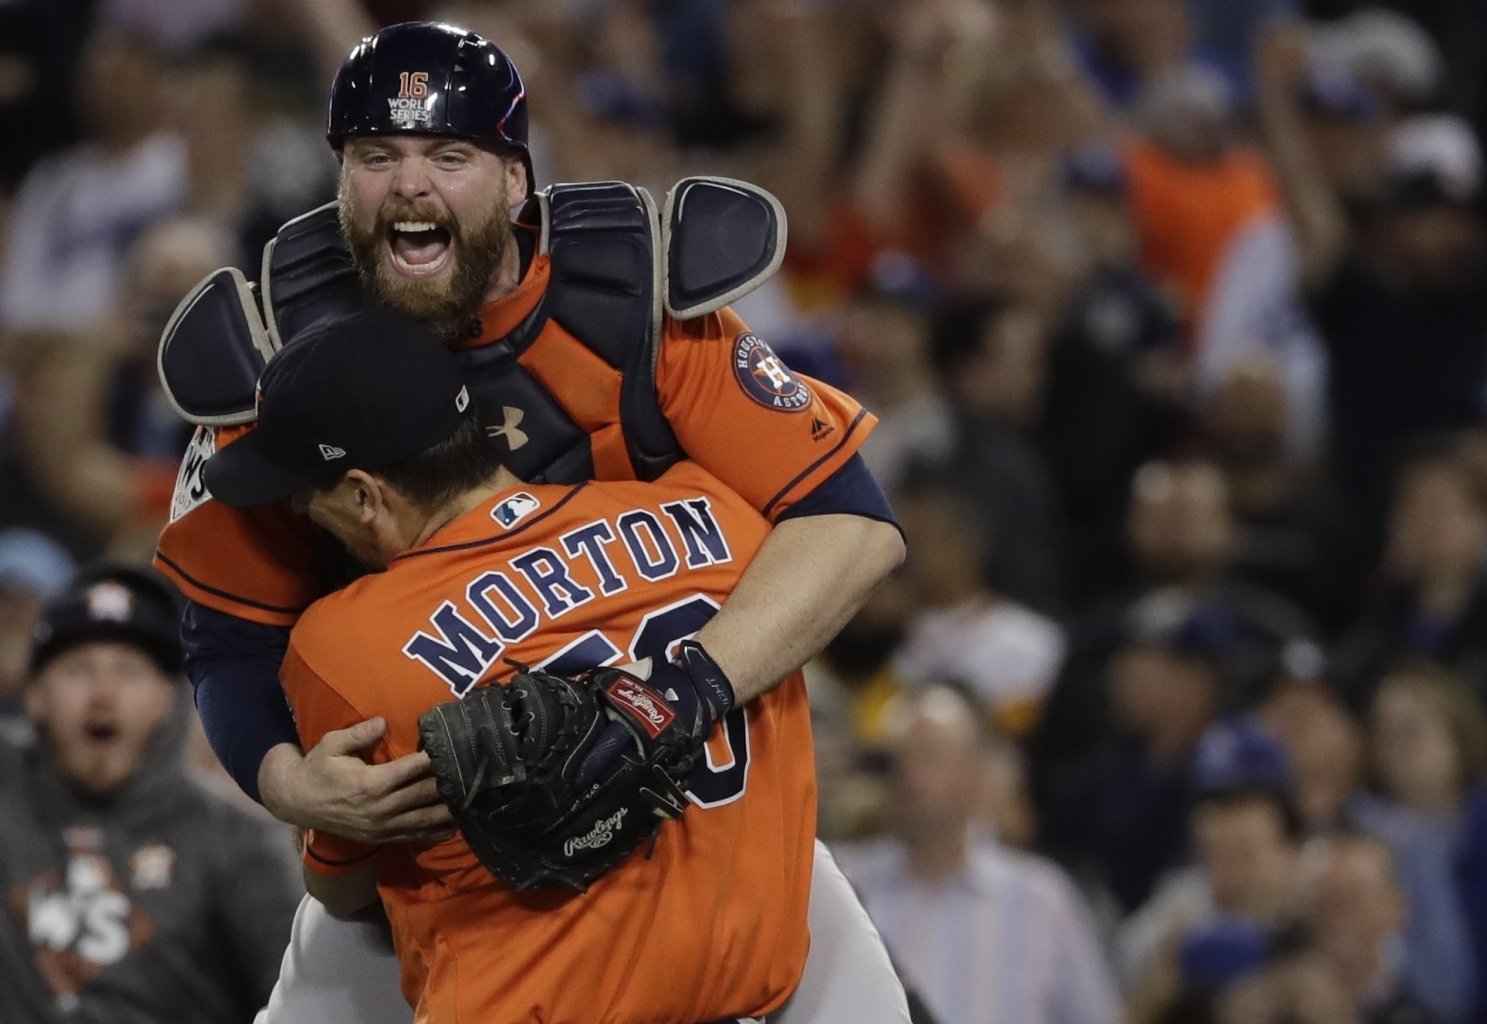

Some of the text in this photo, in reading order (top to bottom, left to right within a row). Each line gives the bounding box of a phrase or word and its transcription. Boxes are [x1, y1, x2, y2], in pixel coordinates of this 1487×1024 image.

[398, 71, 429, 98] 16
[390, 109, 430, 121] SERIES
[402, 496, 733, 700] MORTON
[527, 593, 752, 810] 0
[617, 688, 665, 724] Rawlings
[563, 807, 628, 857] Rawlings
